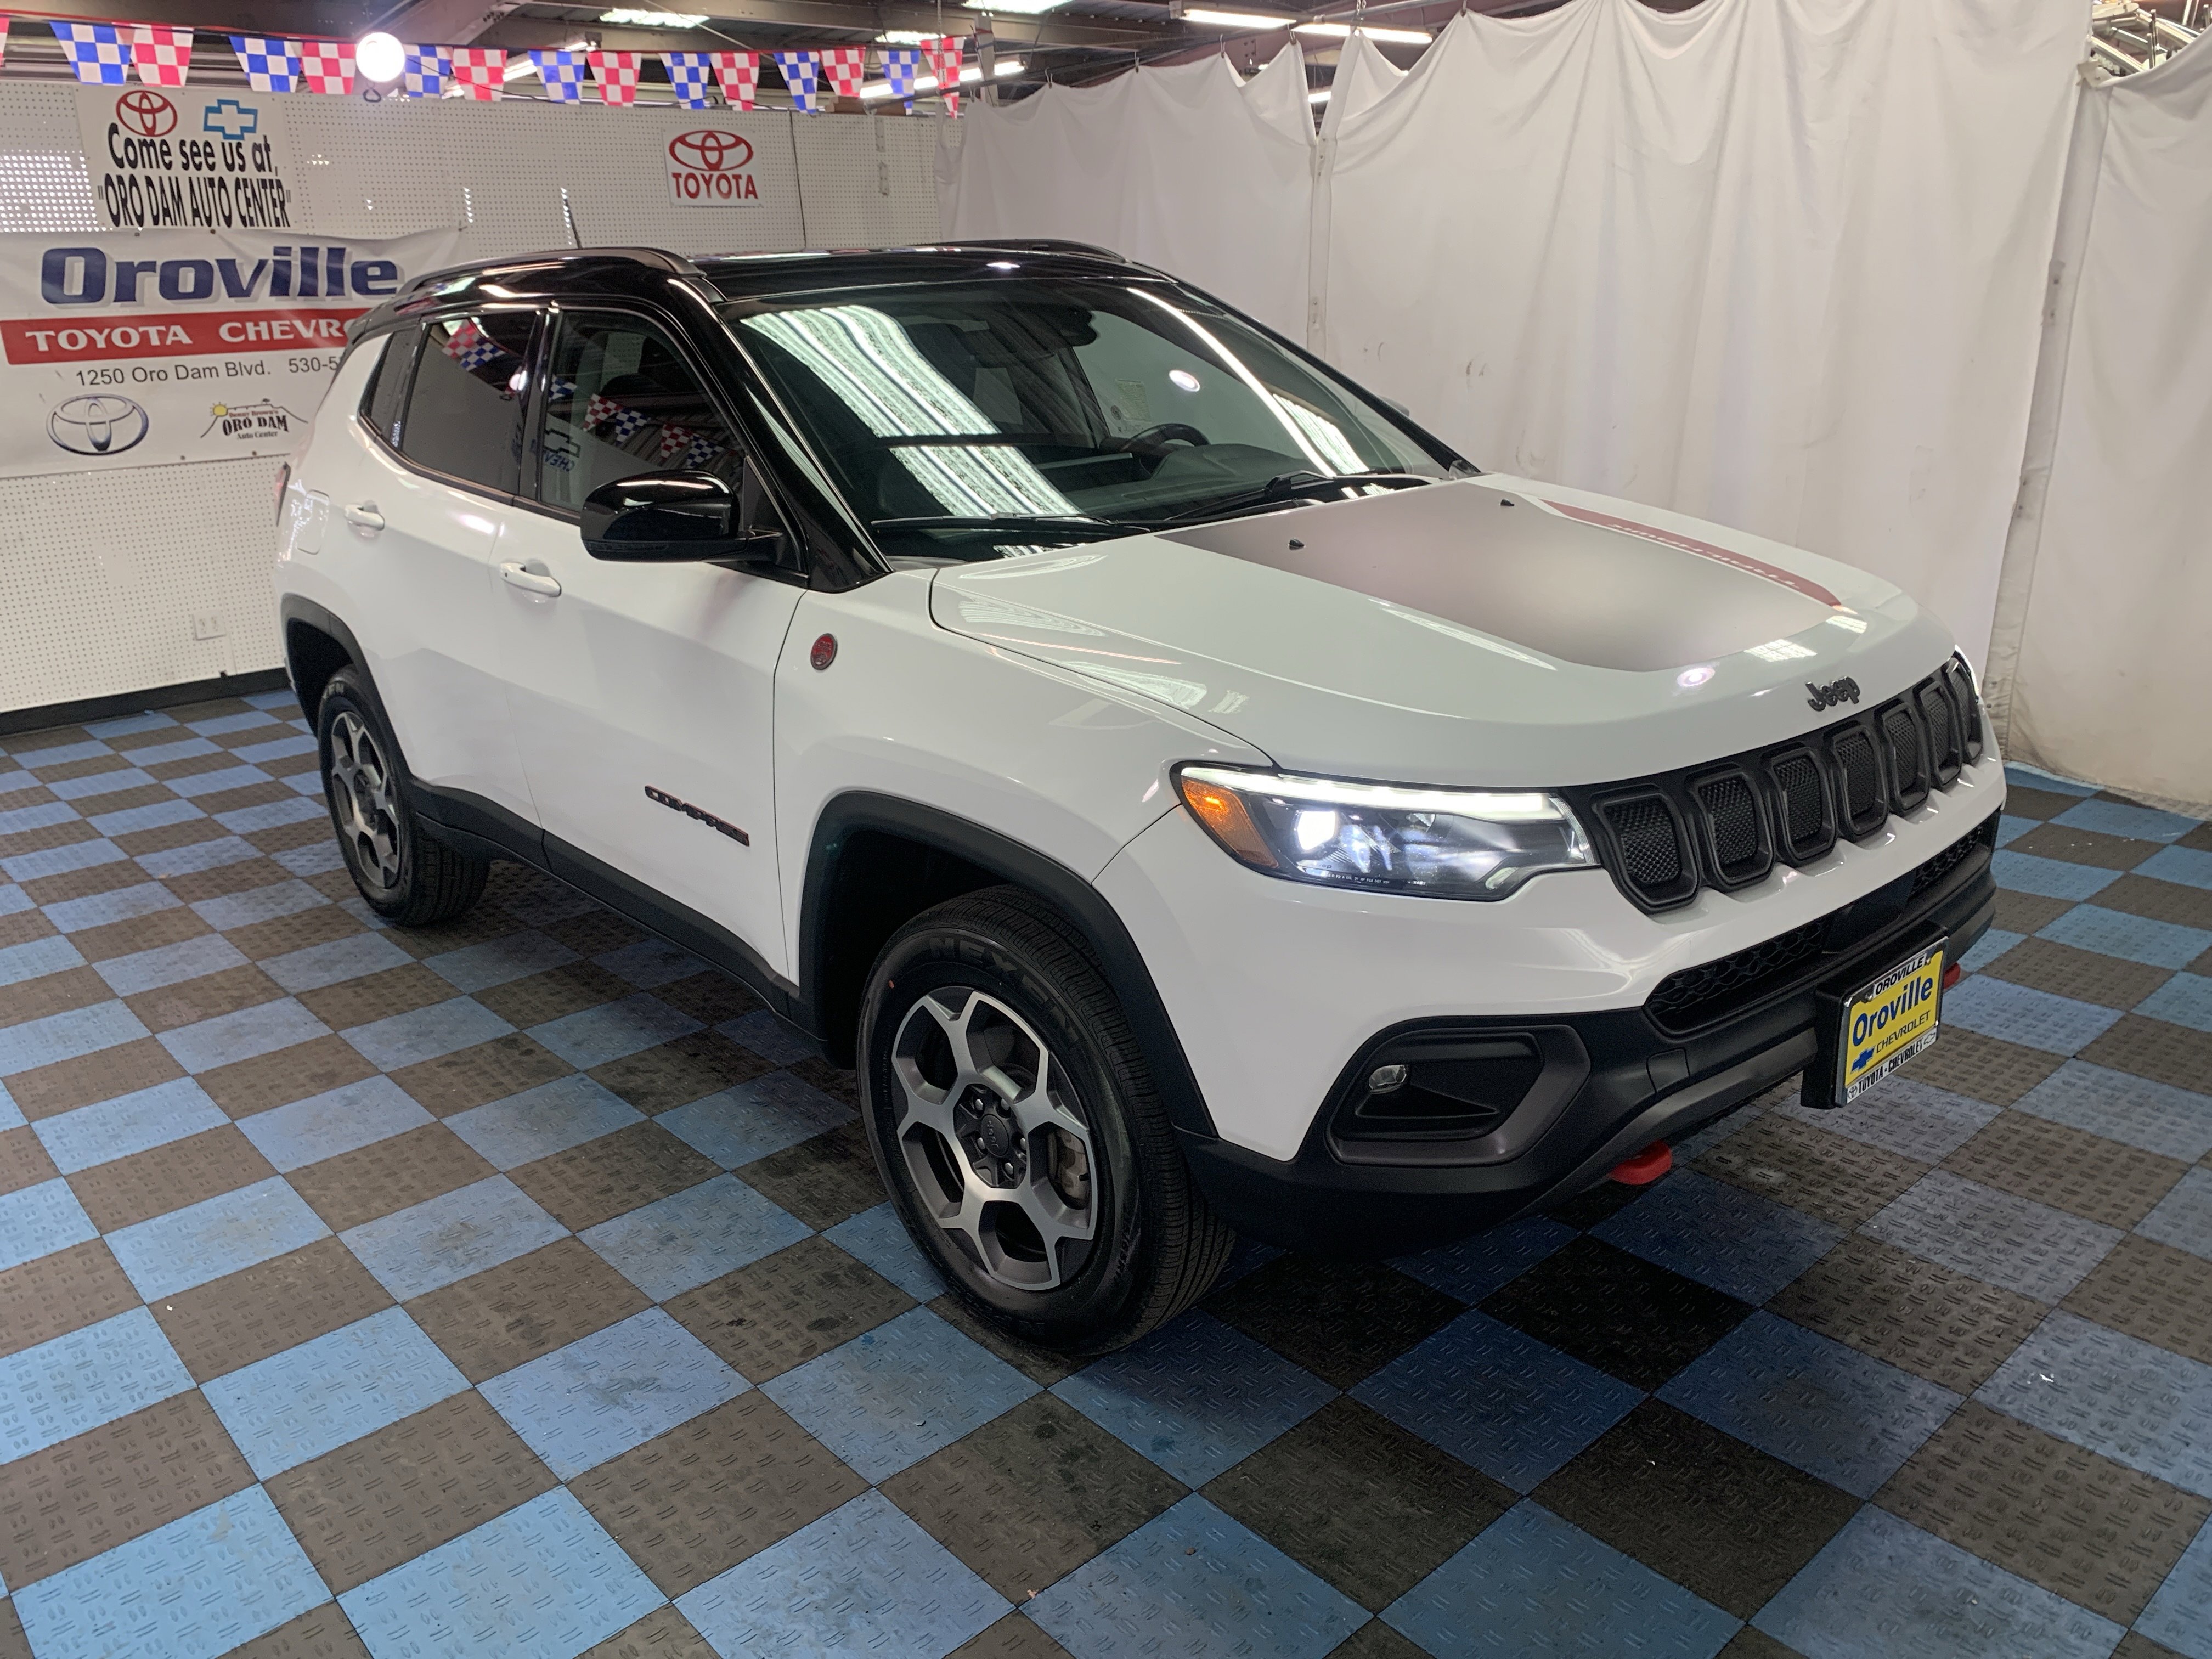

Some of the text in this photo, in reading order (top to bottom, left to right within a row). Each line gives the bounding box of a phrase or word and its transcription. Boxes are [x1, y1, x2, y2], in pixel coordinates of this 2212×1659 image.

[108, 122, 172, 170] Come
[179, 139, 216, 171] see
[221, 141, 246, 172] us
[144, 176, 188, 226] DAM
[188, 176, 232, 228] AUTO
[672, 172, 758, 199] TOYOTA
[41, 246, 398, 305] Oroville
[26, 325, 193, 352] TOYOTA
[76, 356, 341, 386] 1250 Oro Dam Blvd. 530-5
[222, 415, 289, 436] ORO DAM
[237, 432, 253, 440] Auto
[1805, 676, 1861, 712] Jeep
[1876, 956, 1926, 995] OROVILLE
[1852, 977, 1933, 1047] Oroville
[1876, 1011, 1931, 1053] CHEVROLET
[1858, 1039, 1923, 1094] TOYOTA CHEVROLET
